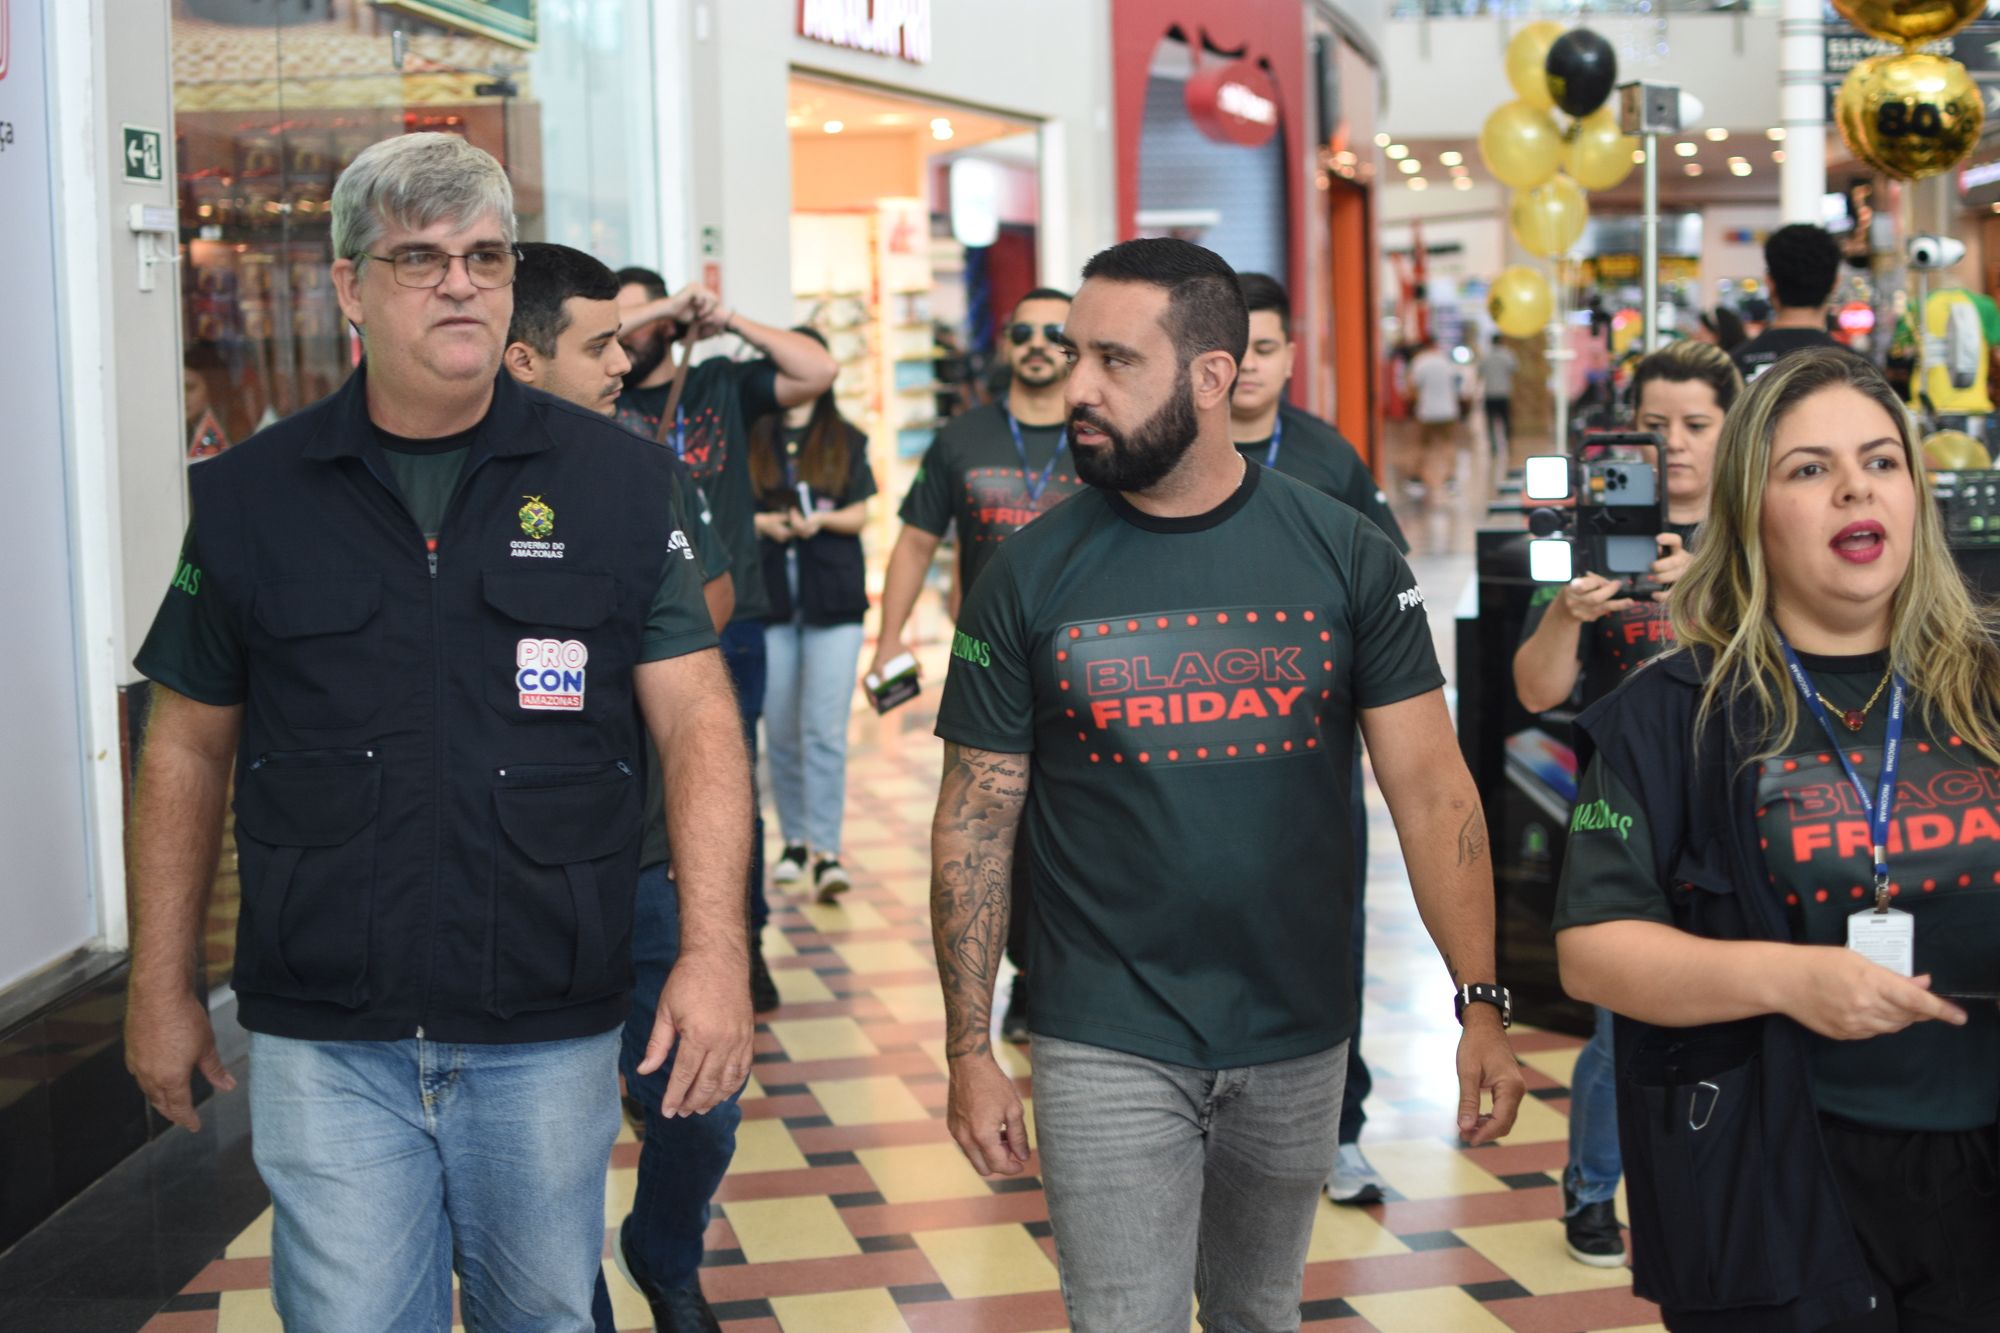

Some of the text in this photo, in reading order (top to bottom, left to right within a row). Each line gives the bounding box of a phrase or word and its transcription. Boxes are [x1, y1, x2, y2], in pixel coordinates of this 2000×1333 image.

[510, 541, 565, 550] GOVERNO DO
[511, 549, 564, 559] AMAZONAS
[517, 640, 587, 669] PRO
[519, 668, 583, 693] CON
[1085, 646, 1307, 697] BLACK
[521, 694, 581, 707] AMAZONAS
[1089, 686, 1306, 730] FRIDAY
[1791, 804, 2000, 864] FRIDA
